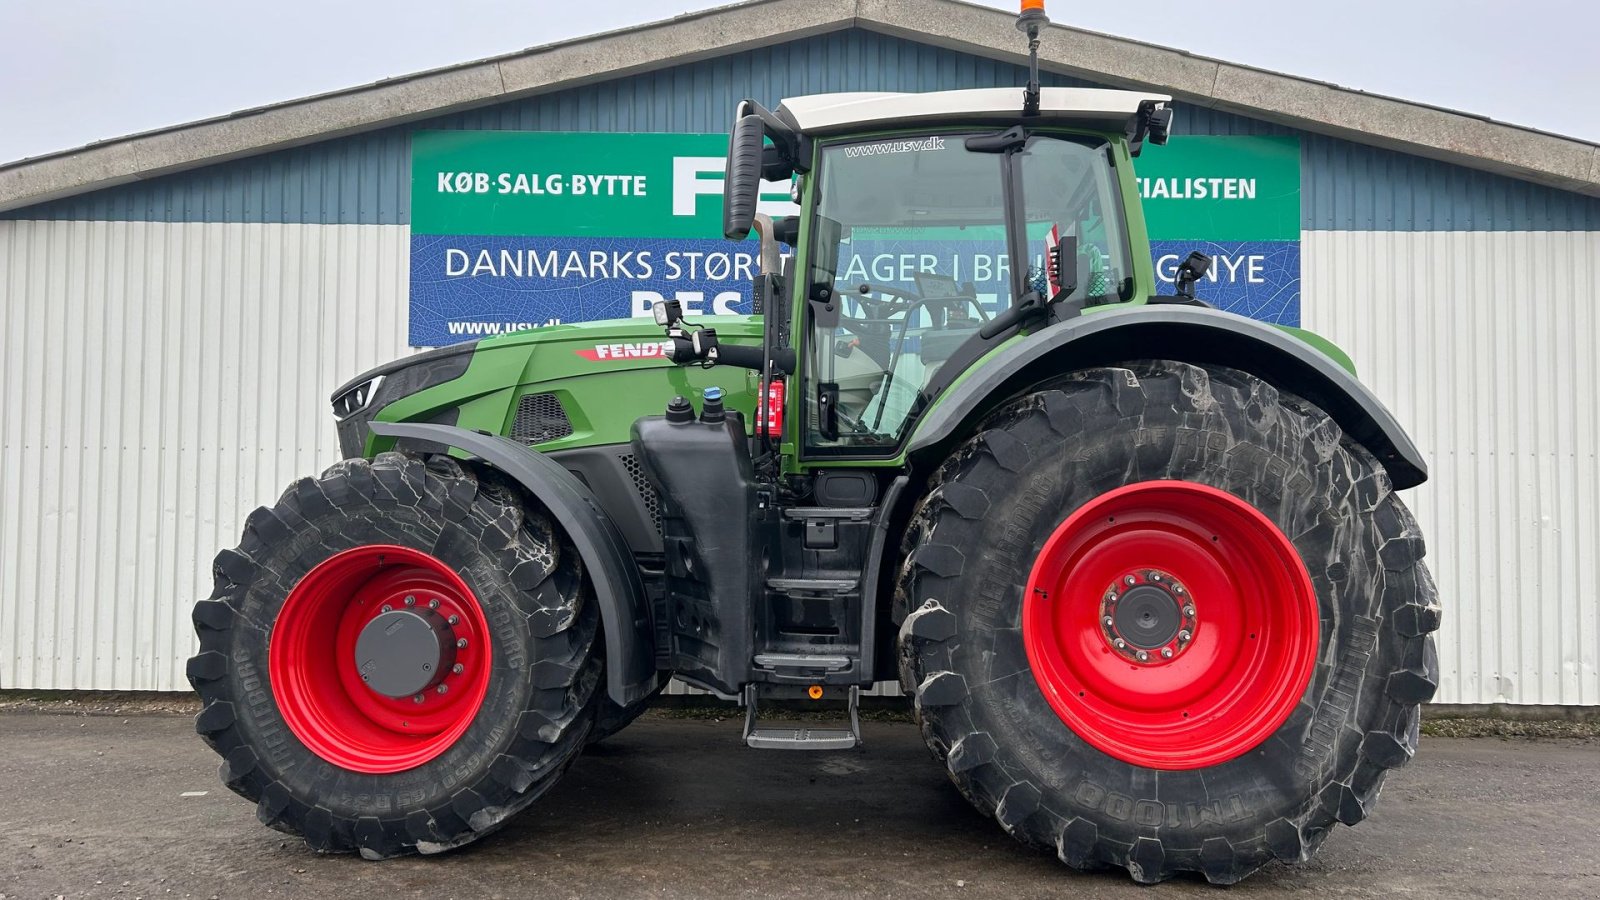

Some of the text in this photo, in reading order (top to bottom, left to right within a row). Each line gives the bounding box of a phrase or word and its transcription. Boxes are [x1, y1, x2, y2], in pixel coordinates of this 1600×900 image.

[845, 137, 945, 157] www.usv.dk
[446, 249, 652, 280] DANMARKS
[1074, 779, 1255, 829] TM1000
